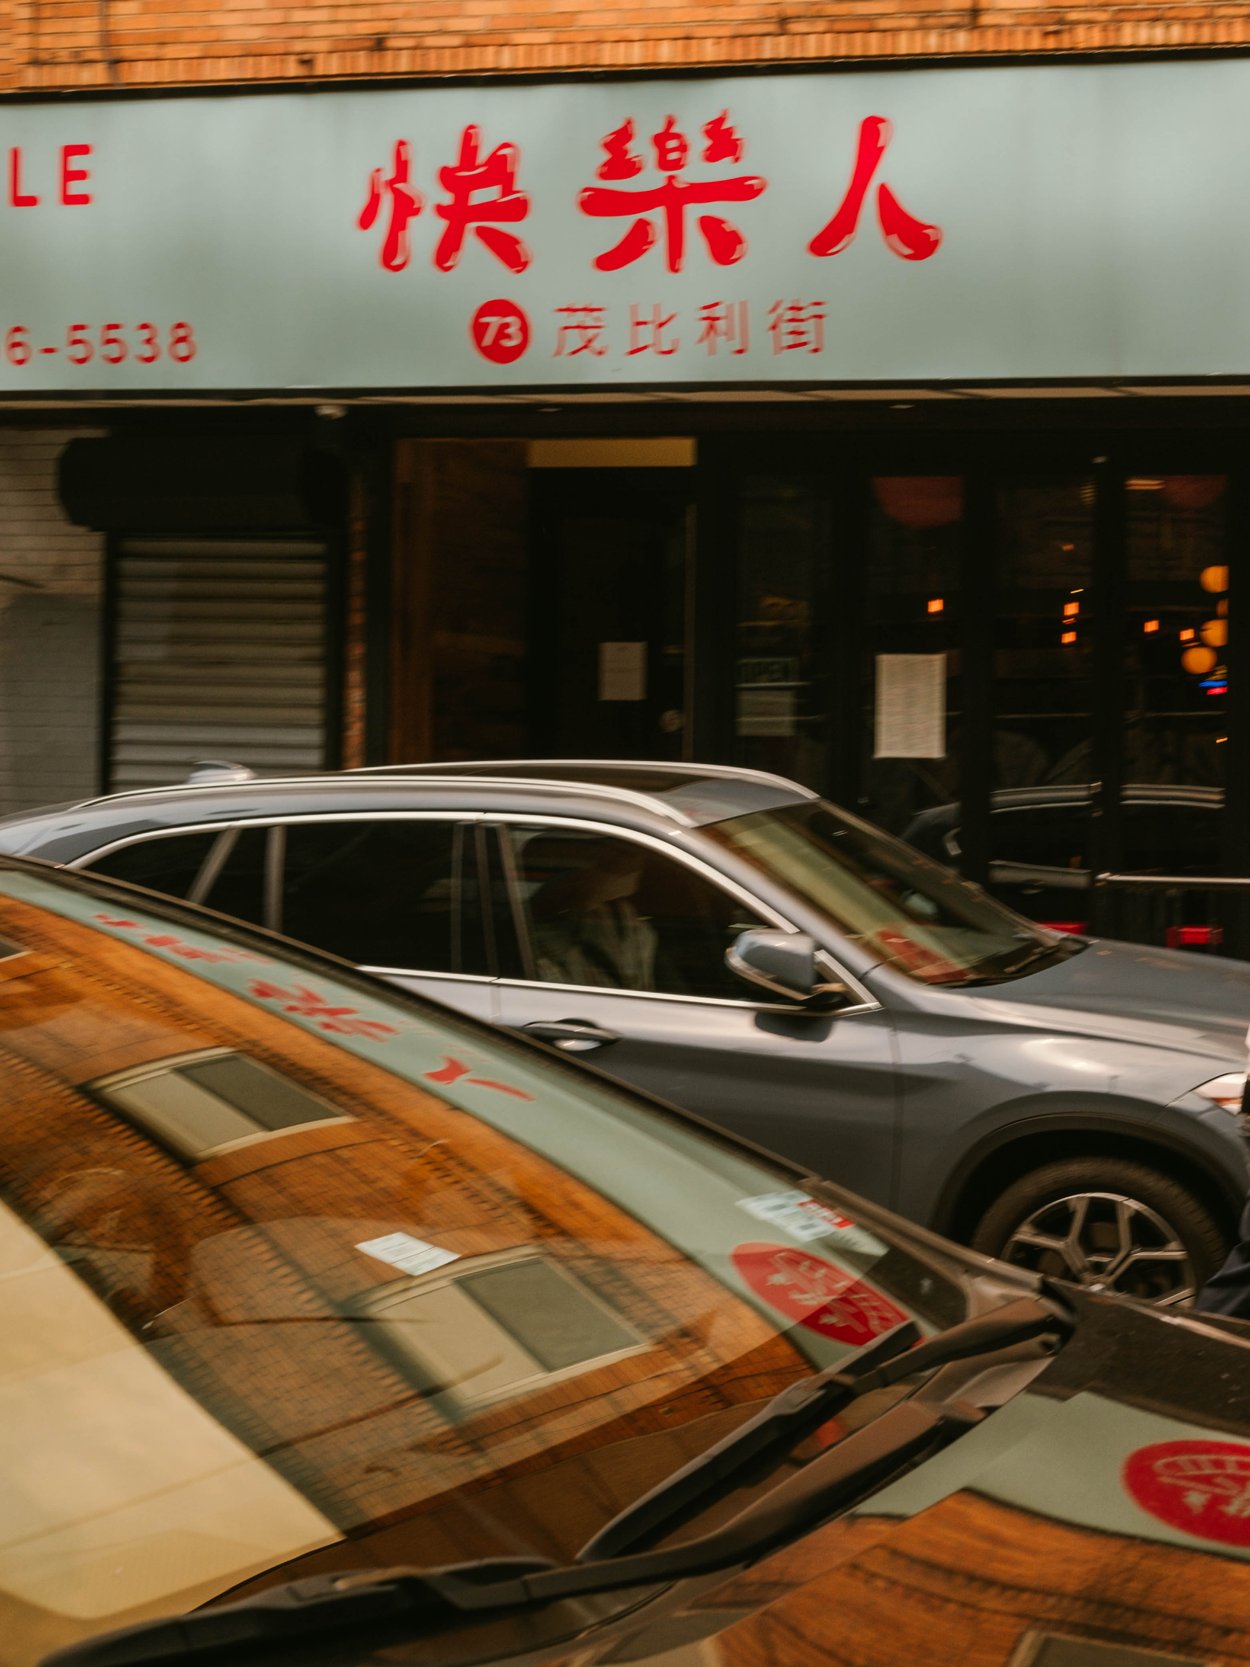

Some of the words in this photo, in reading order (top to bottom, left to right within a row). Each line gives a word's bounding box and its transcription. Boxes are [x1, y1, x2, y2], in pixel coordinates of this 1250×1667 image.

[7, 144, 94, 208] LE
[355, 109, 943, 275] 快樂人
[5, 322, 197, 366] 6-5538
[479, 315, 523, 348] 73
[552, 300, 828, 357] 茂比利街
